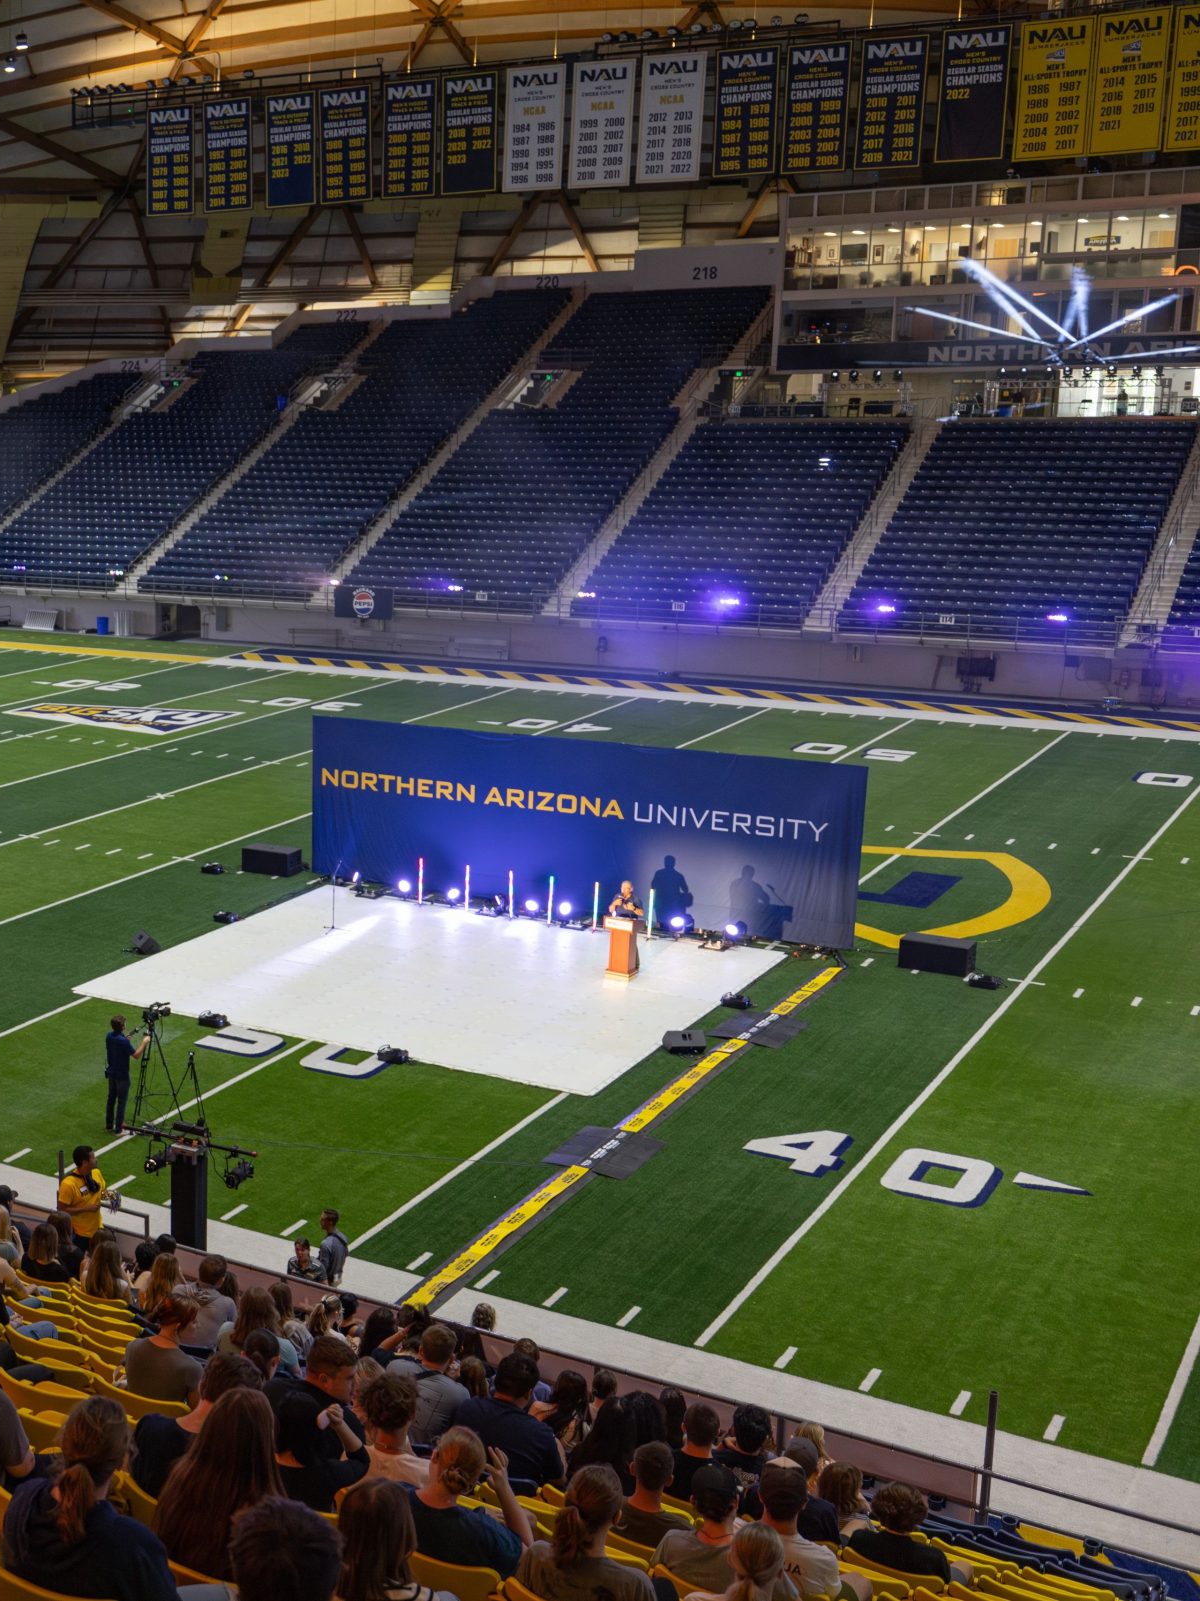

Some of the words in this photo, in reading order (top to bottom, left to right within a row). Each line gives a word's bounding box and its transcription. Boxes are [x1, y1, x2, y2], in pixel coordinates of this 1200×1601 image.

[1105, 16, 1162, 36] NAU
[948, 31, 1005, 50] NAU
[1029, 26, 1086, 44] NAU
[792, 47, 846, 64] NAU
[868, 41, 922, 59] NAU
[722, 52, 773, 70] NAU
[1100, 64, 1136, 73] ALL-SPORTS
[1138, 61, 1162, 69] TROPHY
[650, 60, 697, 75] NAU
[947, 66, 976, 75] REGULAR
[978, 64, 1003, 72] SEASON
[513, 73, 557, 87] NAU
[581, 67, 626, 82] NAU
[946, 73, 1002, 86] CHAMPIONS
[1103, 77, 1124, 87] 2014
[1135, 74, 1157, 84] 2015
[447, 77, 492, 94] NAU
[865, 82, 919, 94] CHAMPIONS
[1028, 84, 1049, 94] 1986
[1060, 82, 1080, 91] 1987
[387, 84, 431, 100] NAU
[721, 91, 772, 104] CHAMPIONS
[791, 87, 843, 100] CHAMPIONS
[946, 88, 970, 100] 2022
[1102, 91, 1123, 102] 2016
[1134, 88, 1155, 99] 2017
[269, 96, 310, 112] NAU
[323, 91, 366, 107] NAU
[660, 95, 684, 104] NCAA
[866, 97, 887, 108] 2010
[896, 95, 916, 106] 2011
[1027, 99, 1048, 108] 1988
[1058, 96, 1079, 106] 1997
[206, 102, 246, 118] NAU
[523, 106, 546, 116] NCAA
[591, 102, 614, 111] NCAA
[1101, 106, 1122, 116] 2018
[1133, 103, 1154, 113] 2019
[150, 108, 189, 123] NAU
[447, 115, 492, 127] CHAMPIONS
[649, 113, 667, 122] 2012
[674, 111, 692, 120] 2013
[865, 111, 886, 121] 2012
[894, 109, 915, 120] 2013
[1024, 113, 1048, 123] 2000
[1056, 110, 1079, 121] 2002
[388, 120, 431, 132] CHAMPIONS
[580, 119, 598, 128] 1999
[605, 118, 624, 127] 2000
[1099, 120, 1120, 130] 2021
[1176, 117, 1198, 127] 2017
[324, 126, 367, 138] CHAMPIONS
[513, 124, 530, 133] 1984
[648, 126, 666, 135] 2014
[673, 125, 691, 134] 2016
[864, 125, 885, 135] 2014
[893, 123, 914, 134] 2016
[1023, 127, 1047, 137] 2004
[1055, 125, 1078, 135] 2007
[270, 131, 311, 143] CHAMPIONS
[513, 137, 529, 145] 1987
[580, 132, 597, 141] 2001
[604, 131, 624, 140] 2002
[1175, 131, 1197, 141] 2021
[151, 143, 190, 153] CHAMPIONS
[208, 137, 247, 149] CHAMPIONS
[578, 145, 597, 154] 2003
[604, 144, 623, 153] 2007
[647, 139, 664, 148] 2017
[672, 138, 690, 147] 2018
[863, 138, 884, 149] 2017
[892, 137, 914, 147] 2018
[1022, 142, 1046, 152] 2008
[1056, 139, 1075, 149] 2011
[512, 150, 529, 158] 1990
[646, 152, 664, 161] 2019
[671, 151, 691, 160] 2020
[862, 152, 883, 163] 2019
[891, 150, 912, 161] 2021
[511, 162, 528, 171] 1994
[577, 159, 596, 167] 2008
[603, 157, 622, 166] 2009
[577, 171, 595, 180] 2010
[604, 170, 620, 179] 2011
[645, 165, 663, 174] 2021
[670, 164, 691, 173] 2022
[511, 175, 528, 184] 1996
[693, 267, 717, 280] 218
[536, 276, 559, 289] 220
[336, 310, 358, 322] 222
[121, 360, 141, 372] 224
[31, 704, 113, 717] BIG
[105, 708, 225, 725] SKY
[321, 768, 476, 803] NORTHERN
[484, 787, 624, 820] ARIZONA
[634, 801, 829, 842] UNIVERSITY
